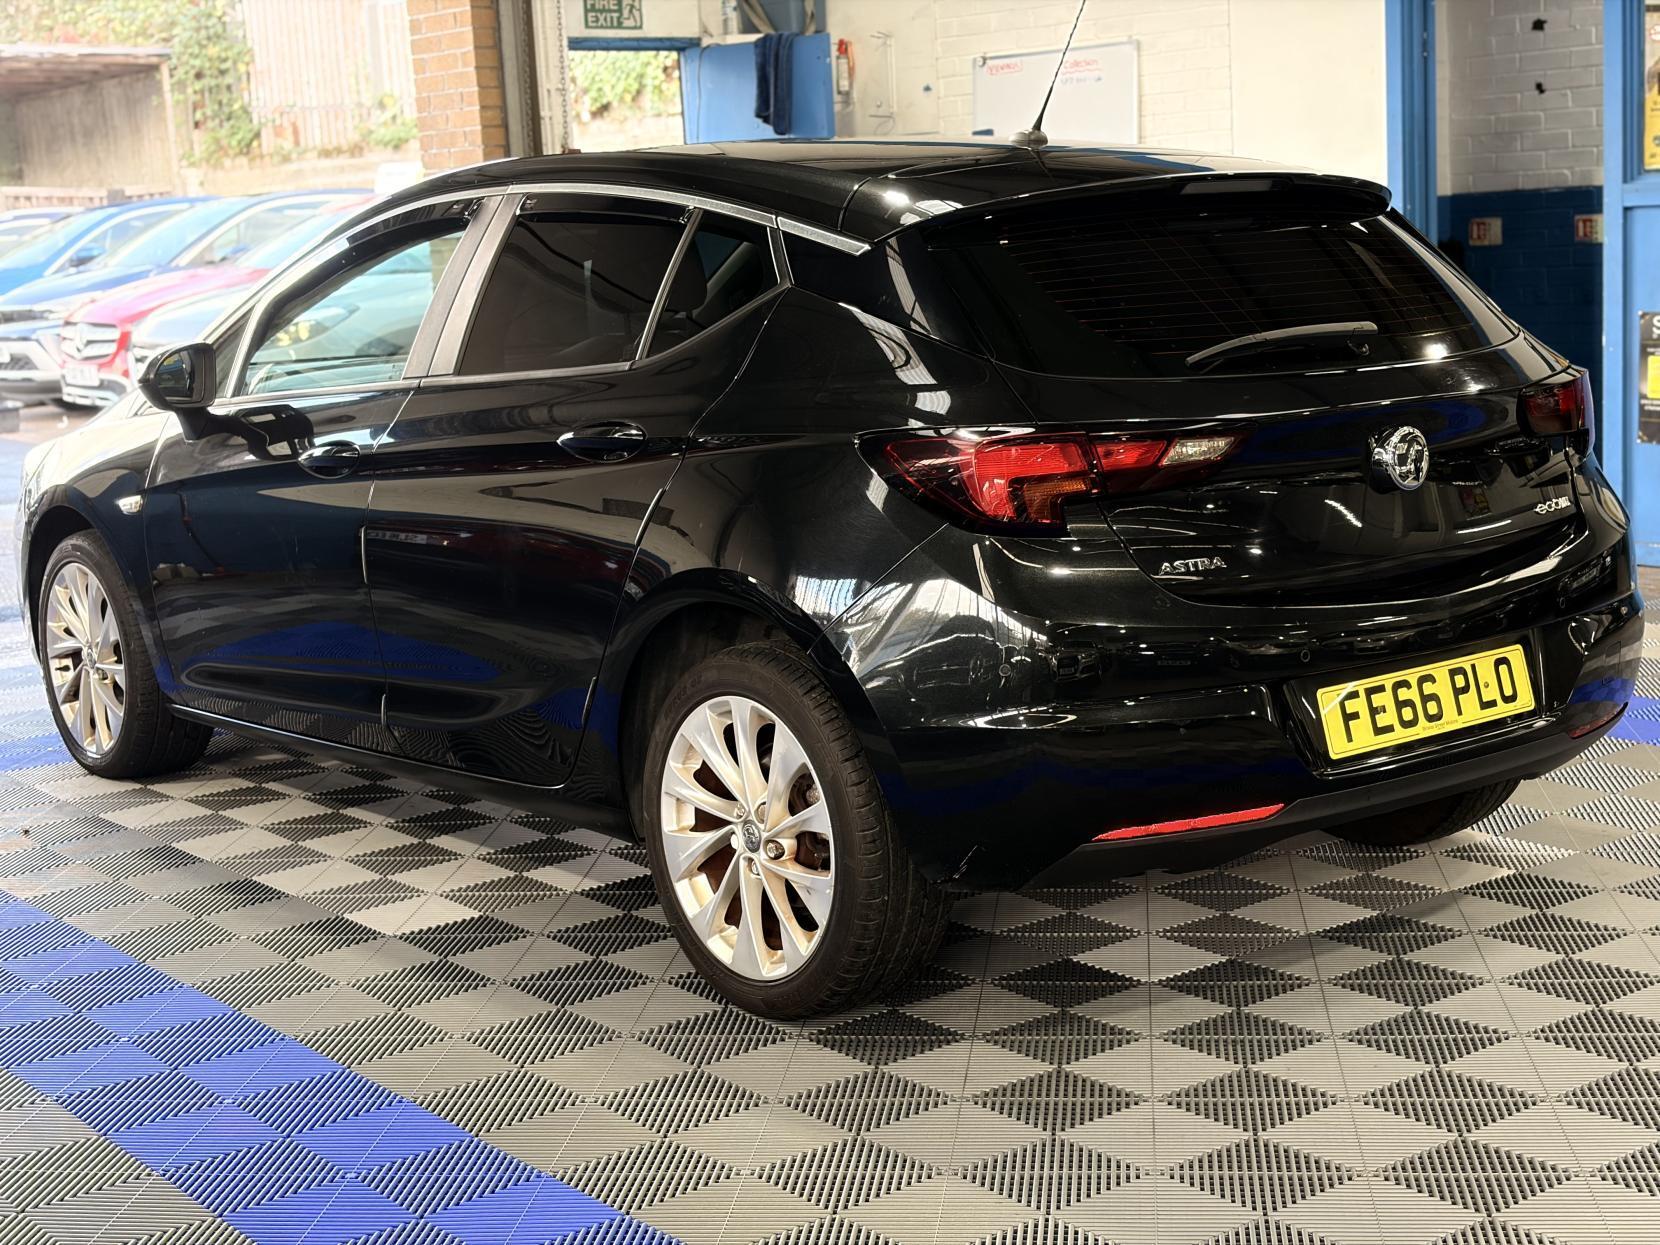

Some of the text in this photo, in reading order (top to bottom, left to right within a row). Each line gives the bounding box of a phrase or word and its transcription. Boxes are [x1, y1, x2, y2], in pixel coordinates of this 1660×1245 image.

[586, 0, 619, 10] FIRE
[587, 12, 620, 27] EXIT
[1159, 556, 1227, 576] ASTRA
[1337, 656, 1519, 743] FE66 PLO
